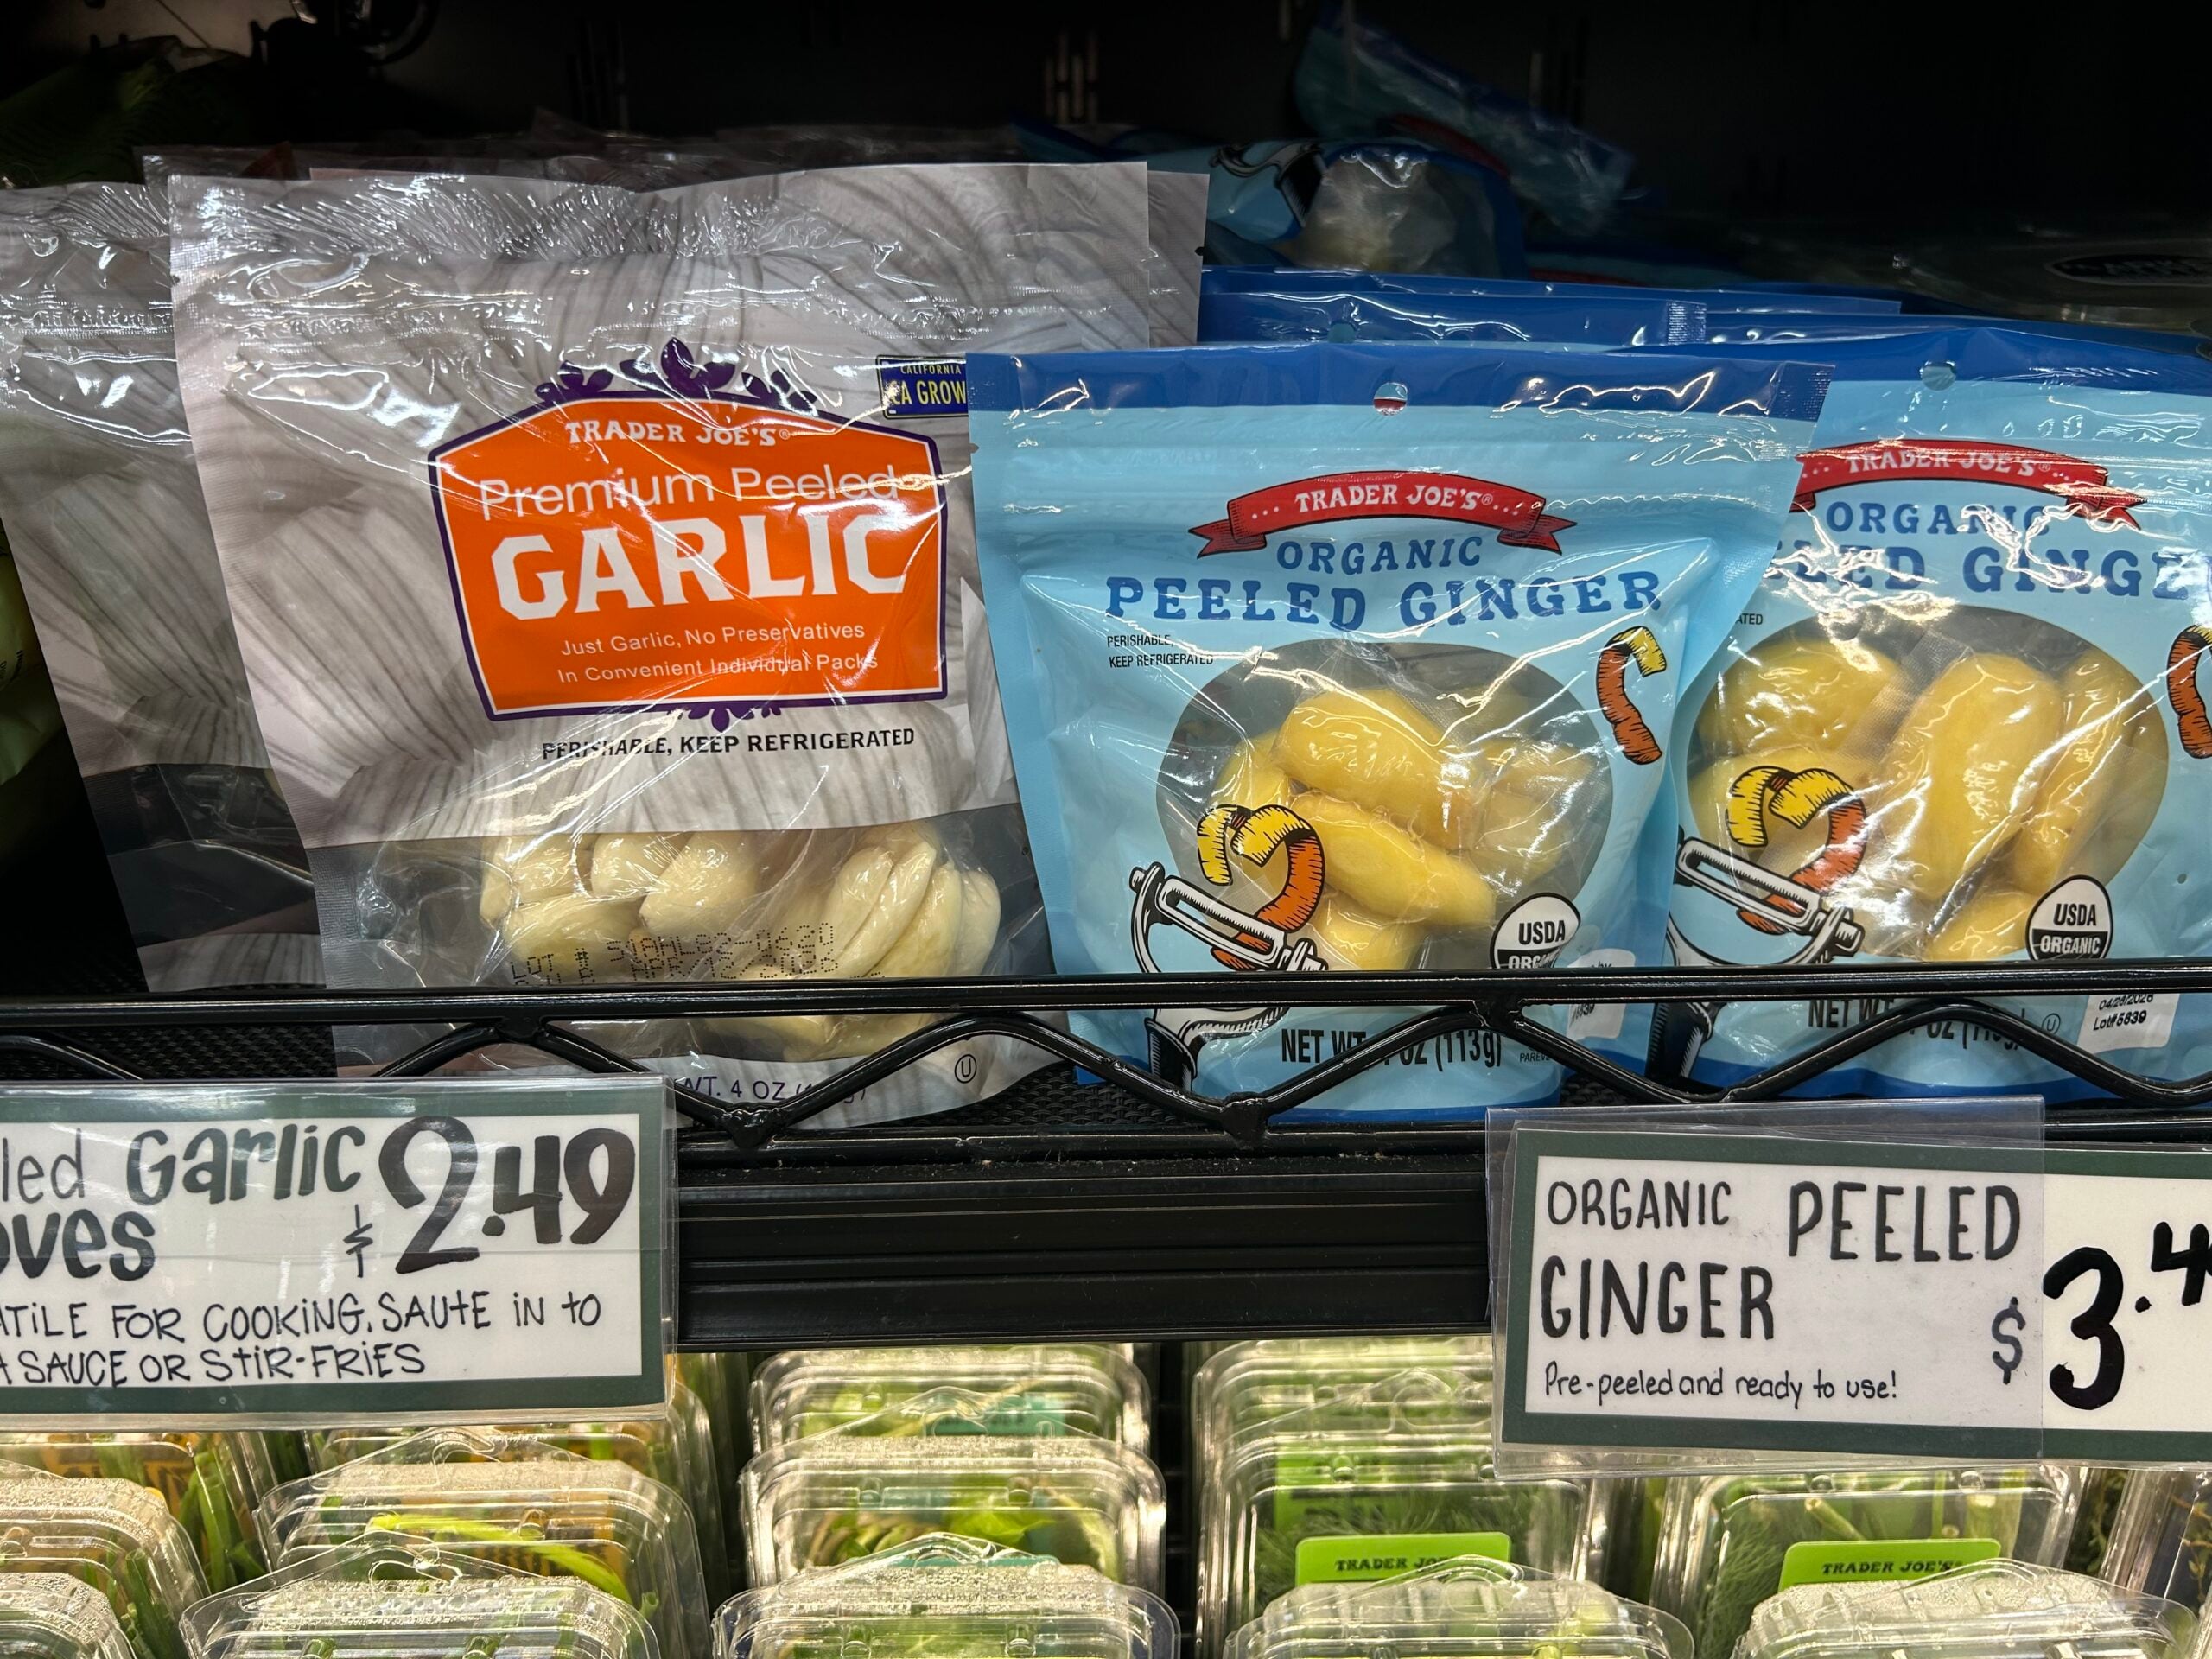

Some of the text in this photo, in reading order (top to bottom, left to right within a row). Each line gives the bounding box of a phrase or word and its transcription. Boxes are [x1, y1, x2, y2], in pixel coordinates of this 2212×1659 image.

[900, 365, 962, 374] CALIFORNIA
[566, 420, 683, 446] TRADER
[1845, 448, 1950, 474] TRADER
[477, 463, 899, 522] Premium Peeled
[1295, 484, 1398, 513] TRADER
[1825, 501, 2050, 535] ORGANIC
[490, 514, 906, 621] GARLIC
[1276, 536, 1483, 575] ORGANIC
[1962, 545, 2212, 601] GINGE
[1106, 570, 1662, 632] PEELED GINGER
[560, 622, 866, 657] Just Garlic, No Preservatives
[1107, 634, 1174, 648] PERISHABLE,
[557, 653, 879, 683] In Convenient Individual Packs
[1109, 652, 1215, 669] KEEP REFRIGERATED
[542, 728, 915, 760] PERISHABLE, KEEP REFRIGERATED
[2053, 903, 2096, 927] USDA
[1518, 920, 1566, 945] USDA
[2039, 931, 2101, 955] ORGANIC
[510, 953, 555, 980] LOT
[1808, 998, 1852, 1028] NET
[1281, 1028, 1325, 1064] NET
[730, 1079, 743, 1099] 4
[752, 1079, 786, 1101] OZ
[126, 1124, 367, 1206] Garlic
[1547, 1179, 2021, 1263] ORGANIC PEELED
[0, 1208, 156, 1282] ves
[1539, 1255, 1776, 1342] GINGER
[112, 1303, 185, 1342] FOR
[17, 1349, 129, 1387] SAUCE
[139, 1353, 193, 1385] OR
[1544, 1359, 1898, 1411] Pre-peeled and ready to use!
[1334, 1557, 1408, 1573] TRADER
[1821, 1561, 1895, 1575] TRADER
